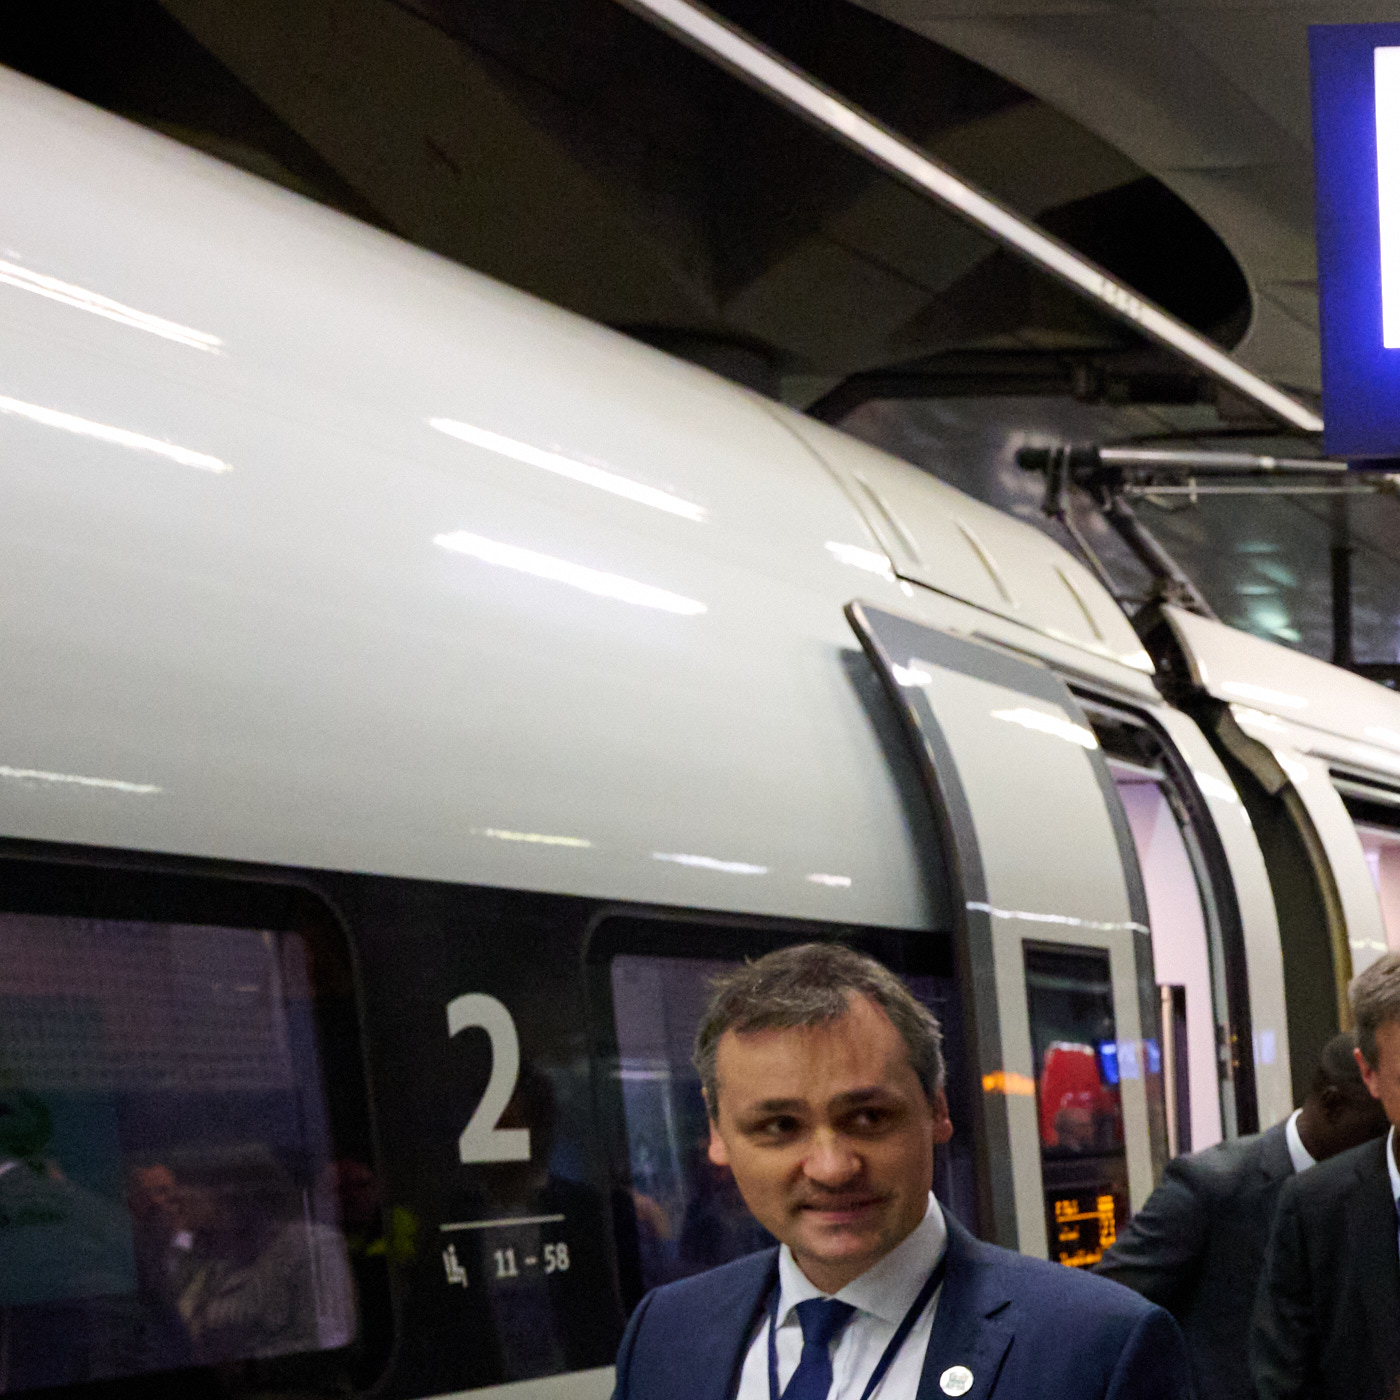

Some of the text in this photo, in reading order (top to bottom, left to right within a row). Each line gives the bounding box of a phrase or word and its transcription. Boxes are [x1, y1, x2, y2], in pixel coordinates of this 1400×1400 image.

[447, 992, 531, 1164] 2
[493, 1248, 519, 1278] 11
[544, 1242, 571, 1275] 58
